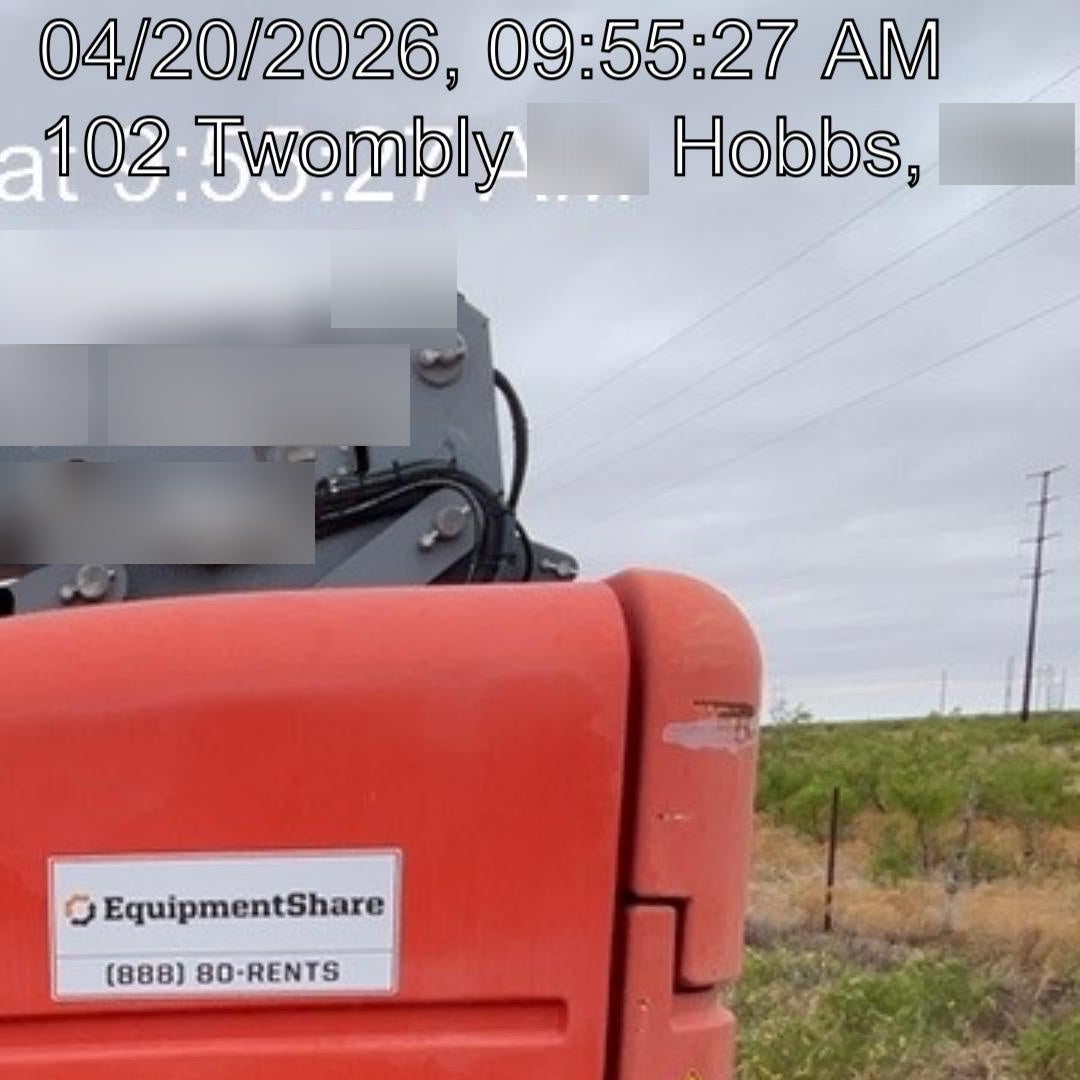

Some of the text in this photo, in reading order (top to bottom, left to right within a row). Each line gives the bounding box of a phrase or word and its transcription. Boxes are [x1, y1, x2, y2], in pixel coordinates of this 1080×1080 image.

[103, 892, 385, 926] EquipmentShare
[106, 960, 340, 987] (888) 80-RENTS
